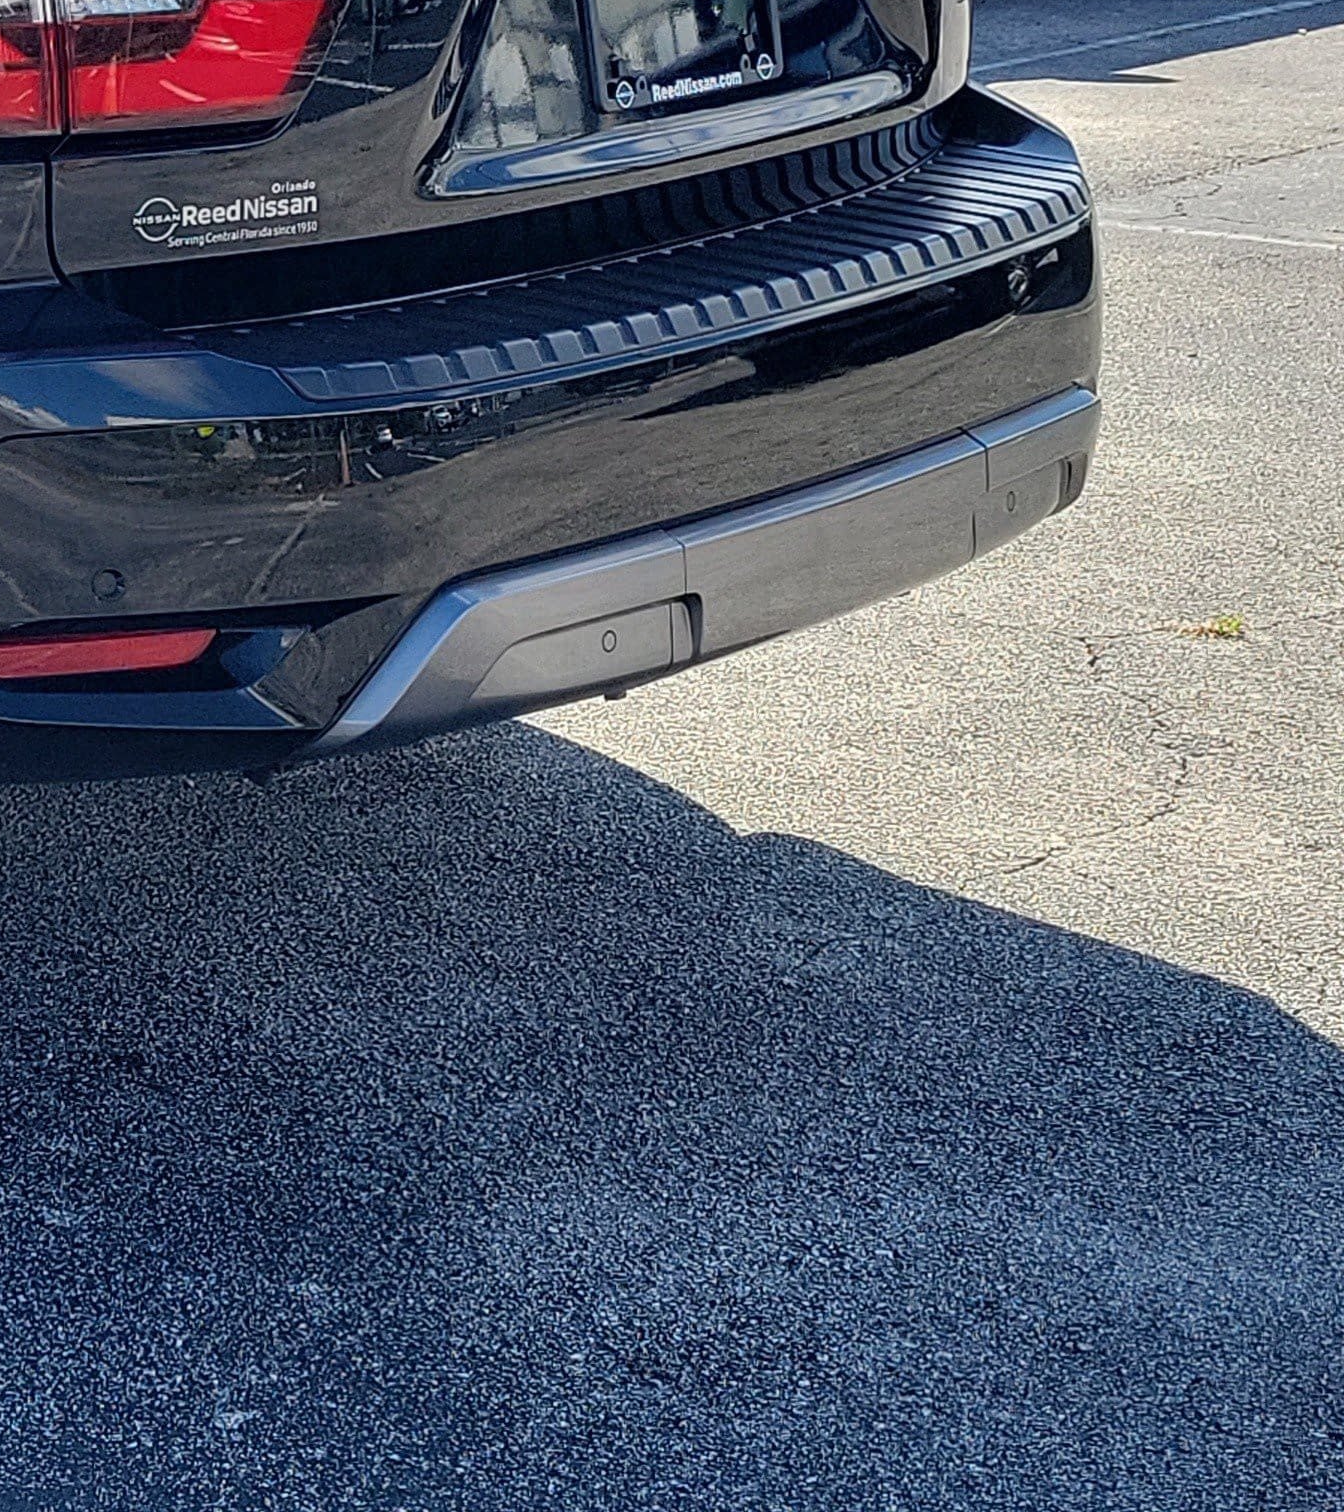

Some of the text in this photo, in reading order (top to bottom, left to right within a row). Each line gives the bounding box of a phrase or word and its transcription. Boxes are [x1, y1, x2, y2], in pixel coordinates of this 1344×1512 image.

[652, 71, 742, 102] ReedNissan.com
[271, 179, 316, 194] Orlando
[133, 212, 182, 226] NISSAN
[167, 234, 205, 248] Serving
[205, 230, 240, 244] Central
[240, 227, 273, 239] Florida
[273, 225, 296, 237] since
